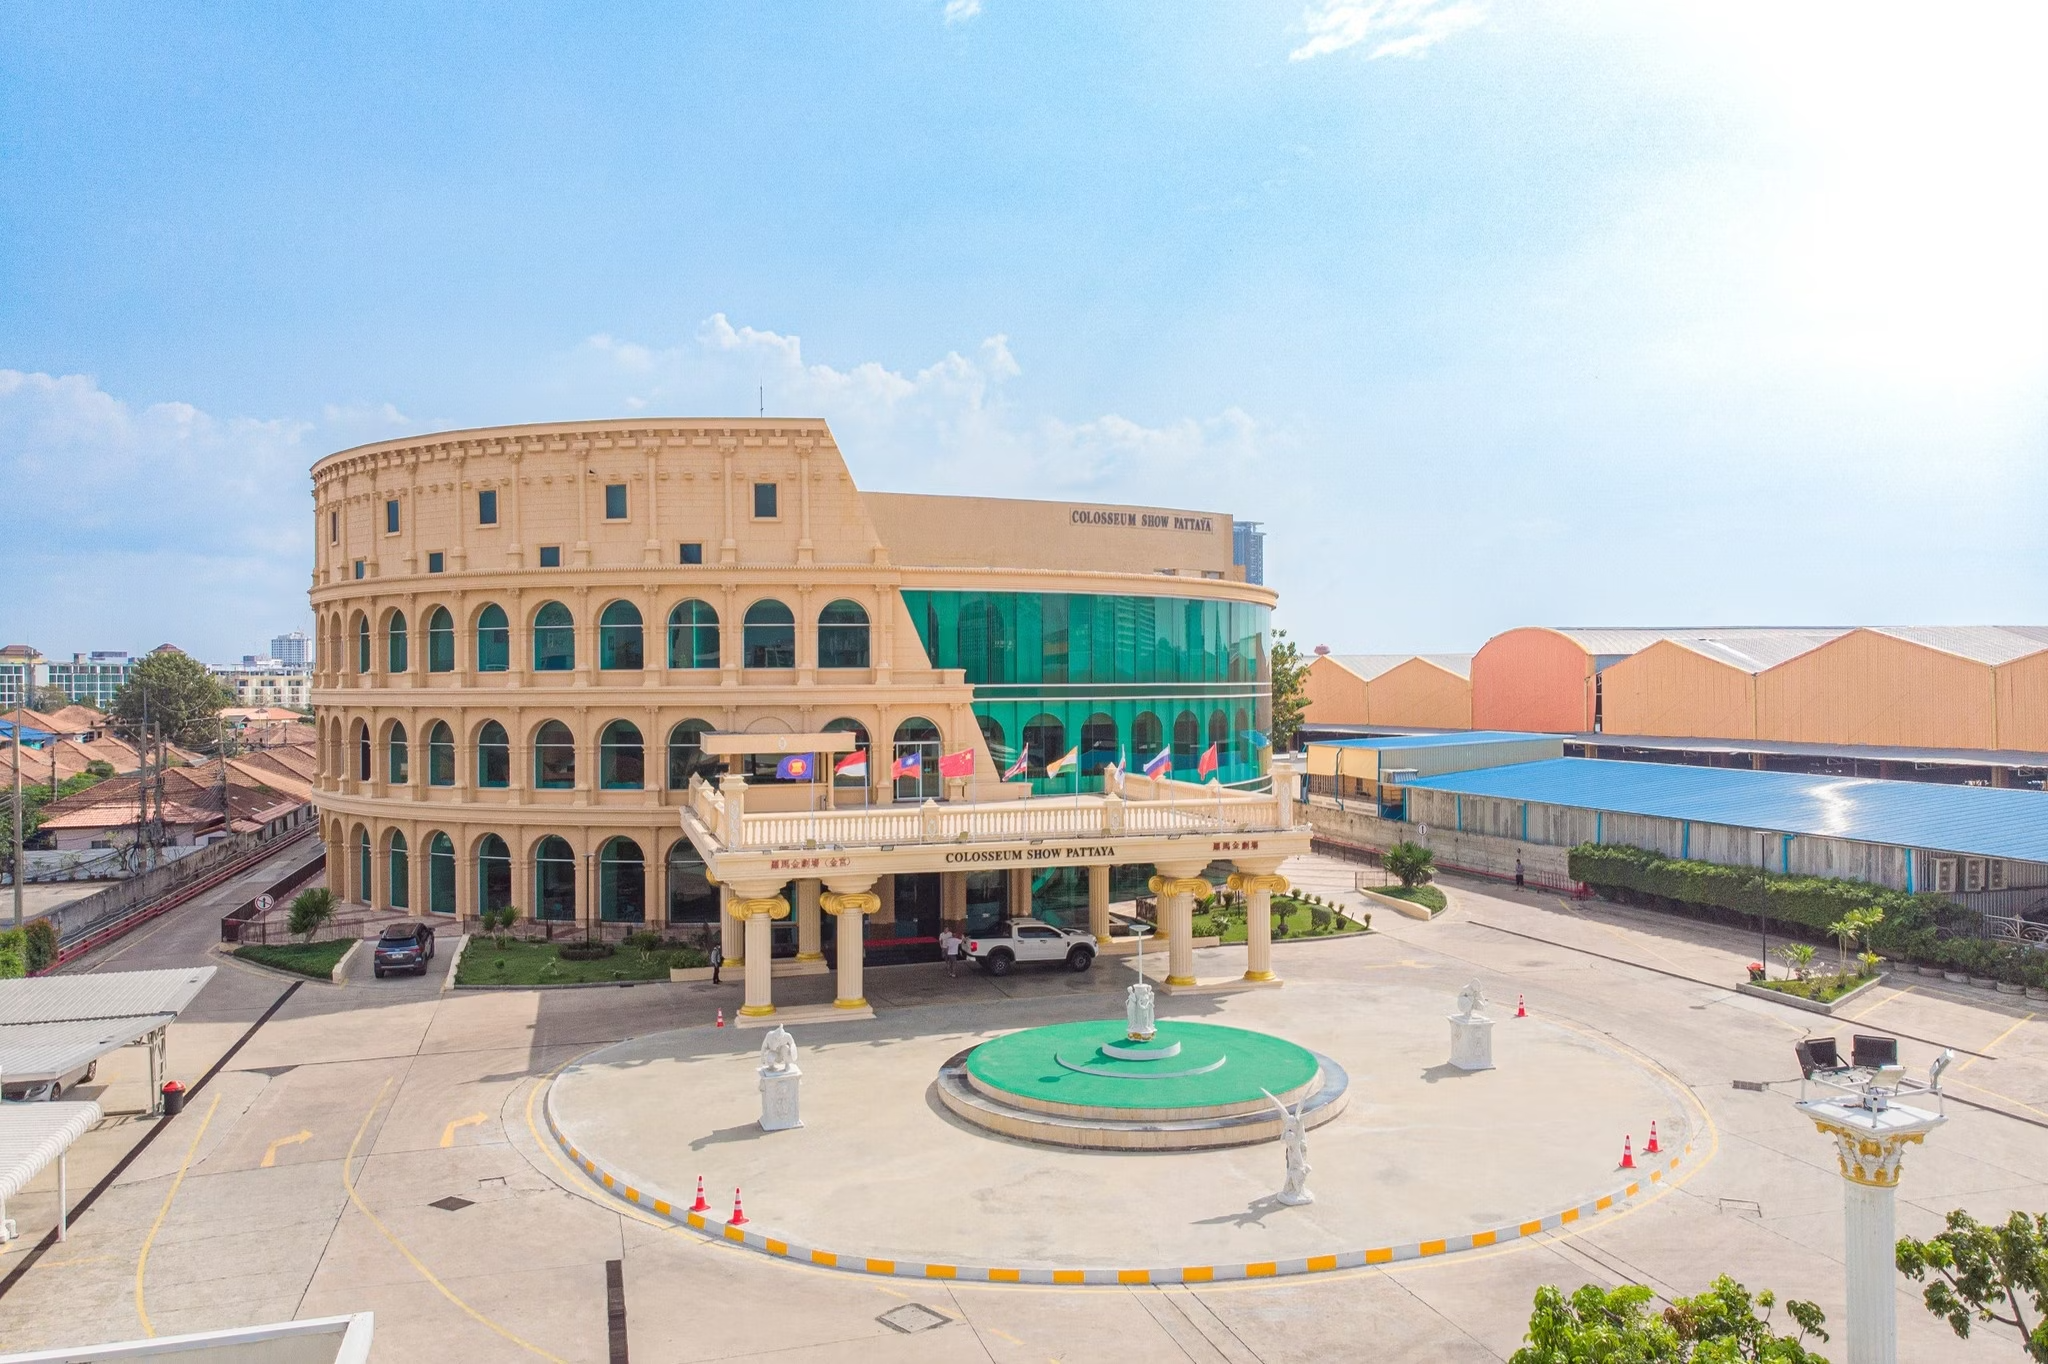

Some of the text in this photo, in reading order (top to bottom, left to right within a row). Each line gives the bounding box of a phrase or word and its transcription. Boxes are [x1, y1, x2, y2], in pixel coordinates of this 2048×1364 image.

[1071, 510, 1212, 532] COLOSSEUM SHOW PATTAYA
[945, 846, 1115, 864] COLOSSEUM SHOW PATTAYA
